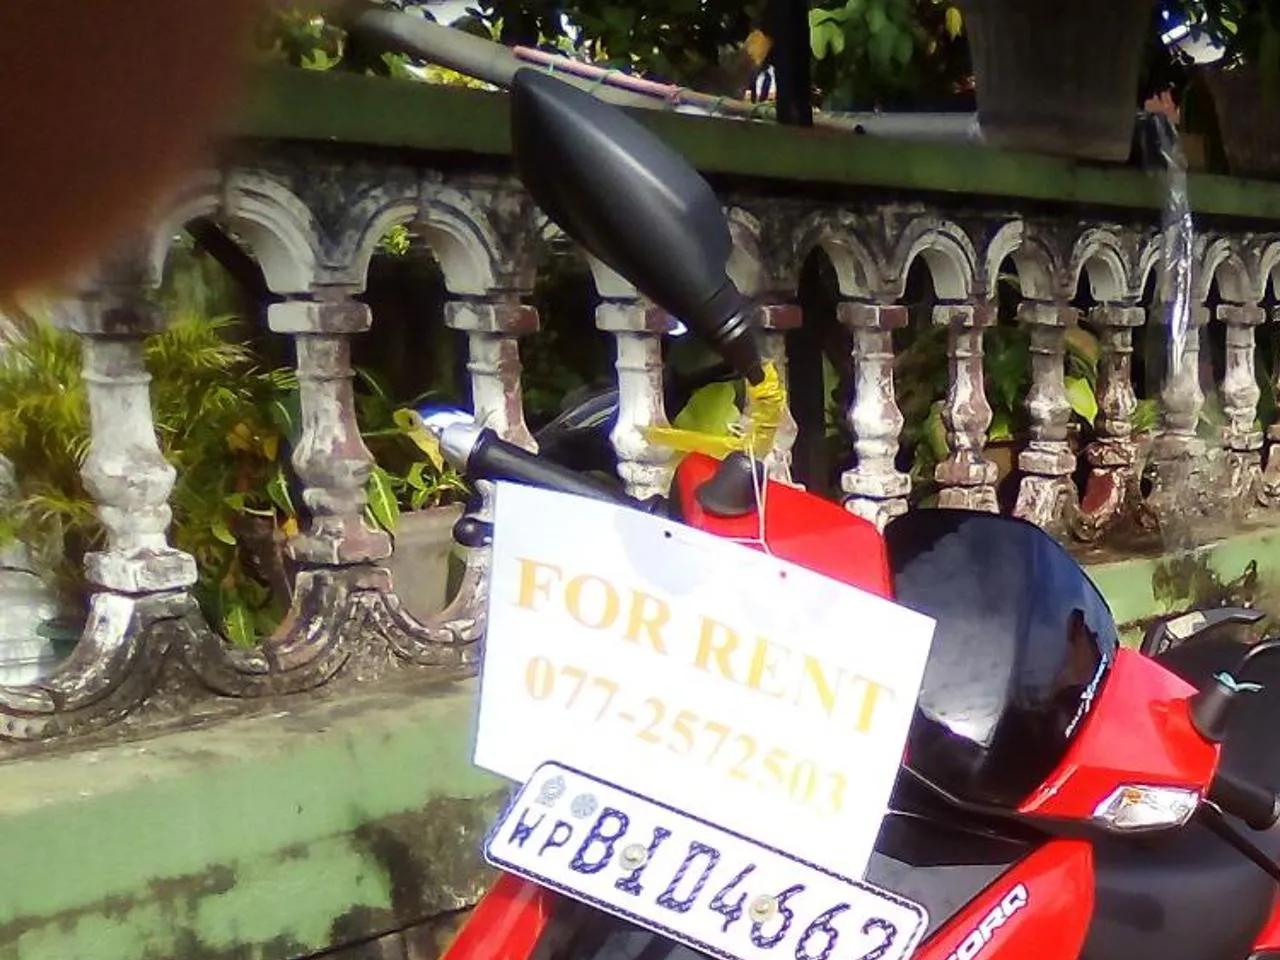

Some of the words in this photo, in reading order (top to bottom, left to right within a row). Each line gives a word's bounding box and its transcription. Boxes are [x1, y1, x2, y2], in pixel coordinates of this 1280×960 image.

[512, 557, 673, 655] FOR
[692, 614, 896, 735] RENT
[523, 655, 850, 816] 077-2572503
[508, 806, 574, 857] WP
